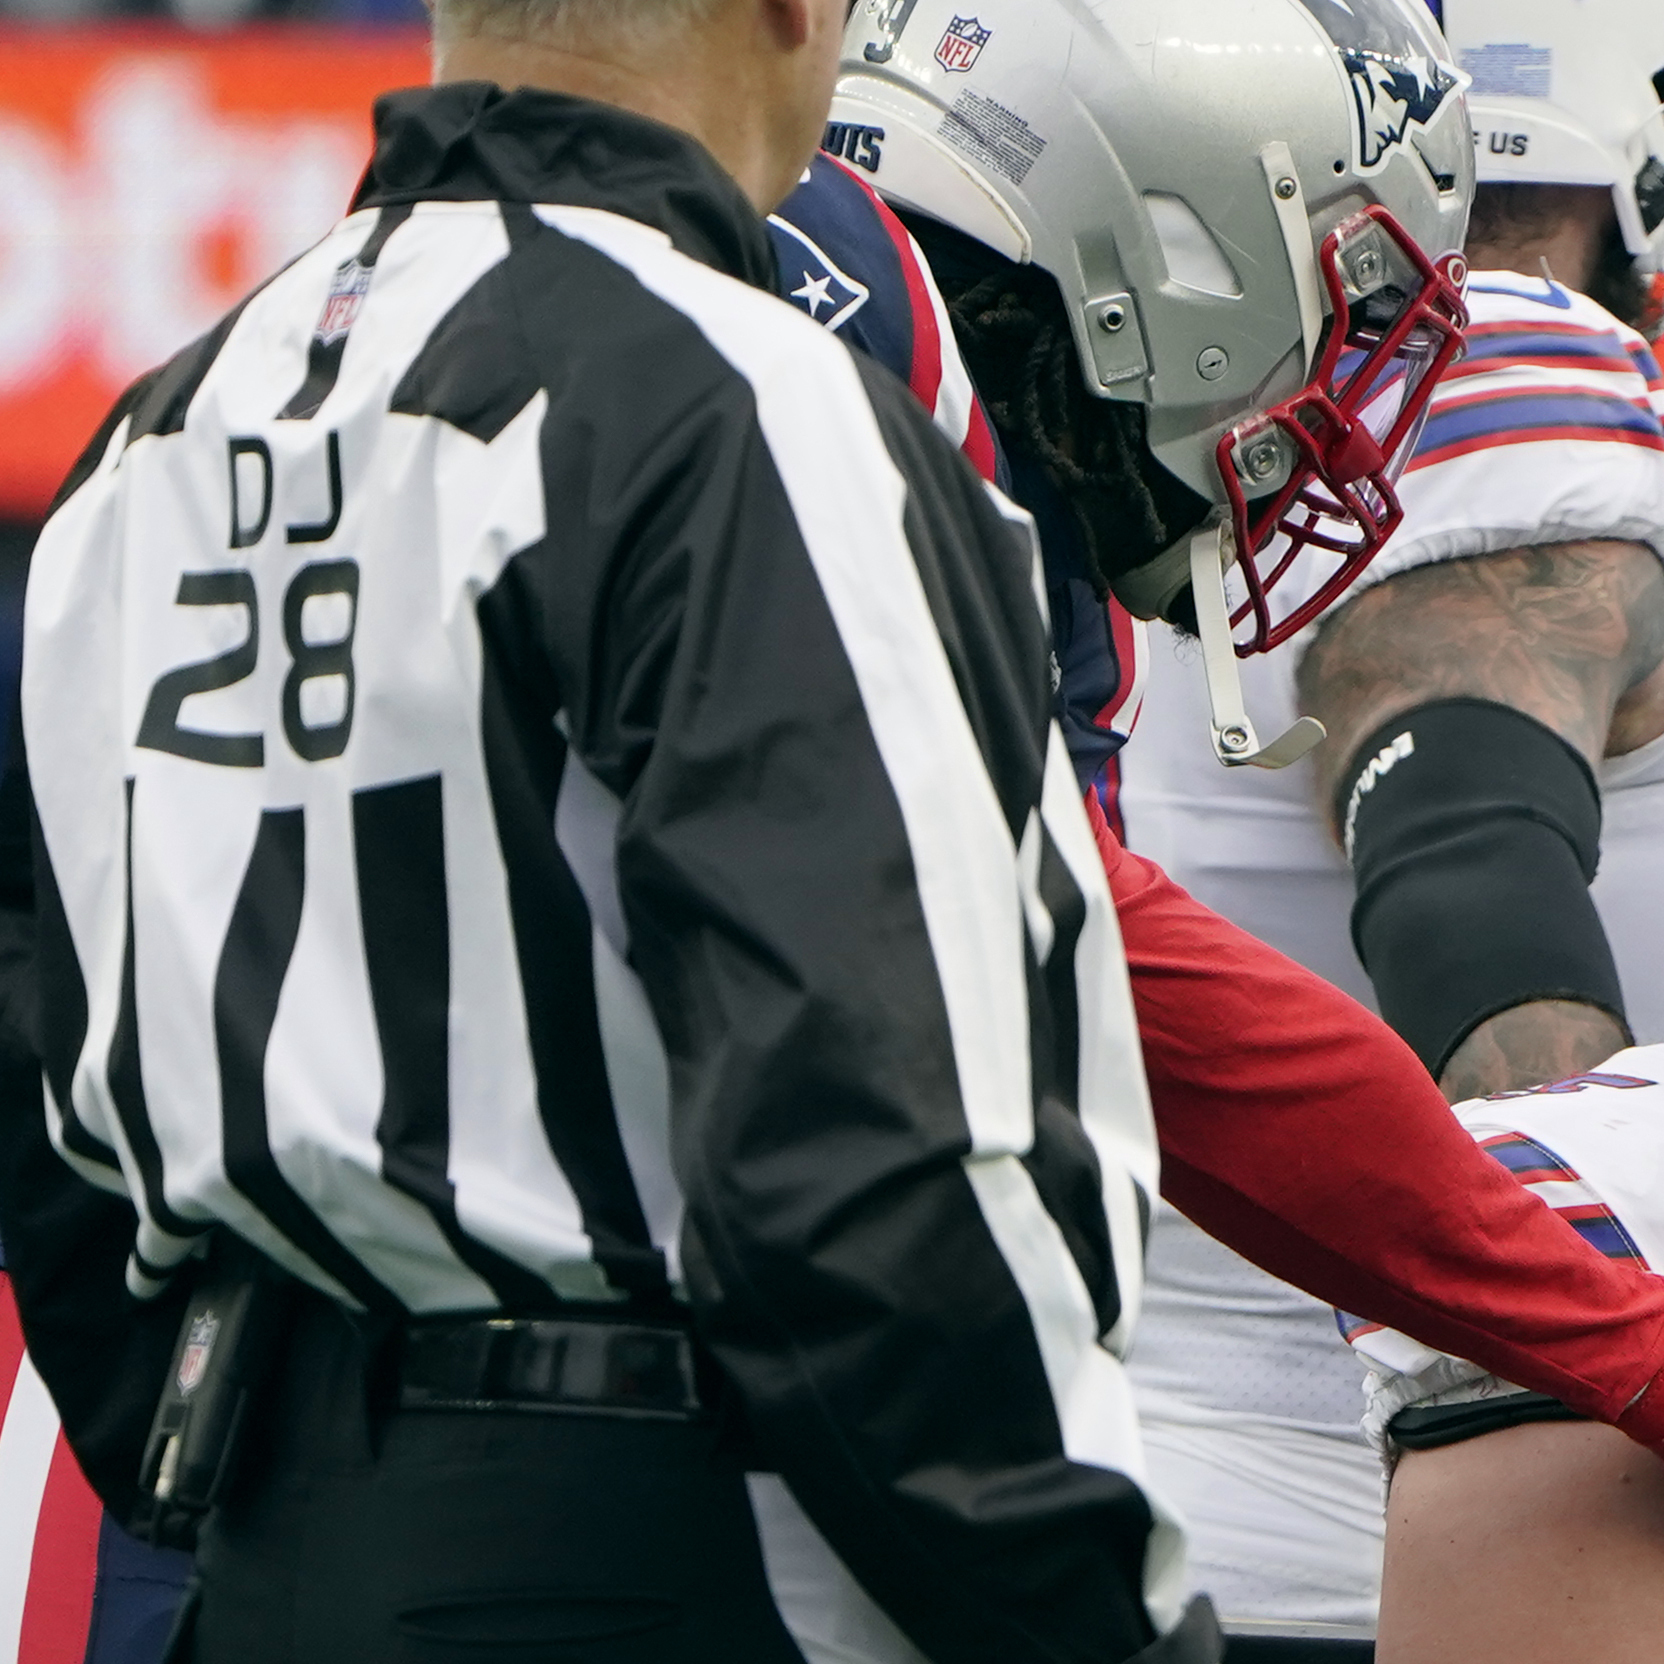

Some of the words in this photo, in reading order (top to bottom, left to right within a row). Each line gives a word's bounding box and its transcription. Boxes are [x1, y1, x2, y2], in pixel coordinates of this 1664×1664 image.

[938, 35, 974, 68] NFL
[985, 96, 1029, 127] WARNING
[1491, 132, 1529, 156] US
[228, 428, 342, 549] DJ
[134, 556, 360, 768] 28
